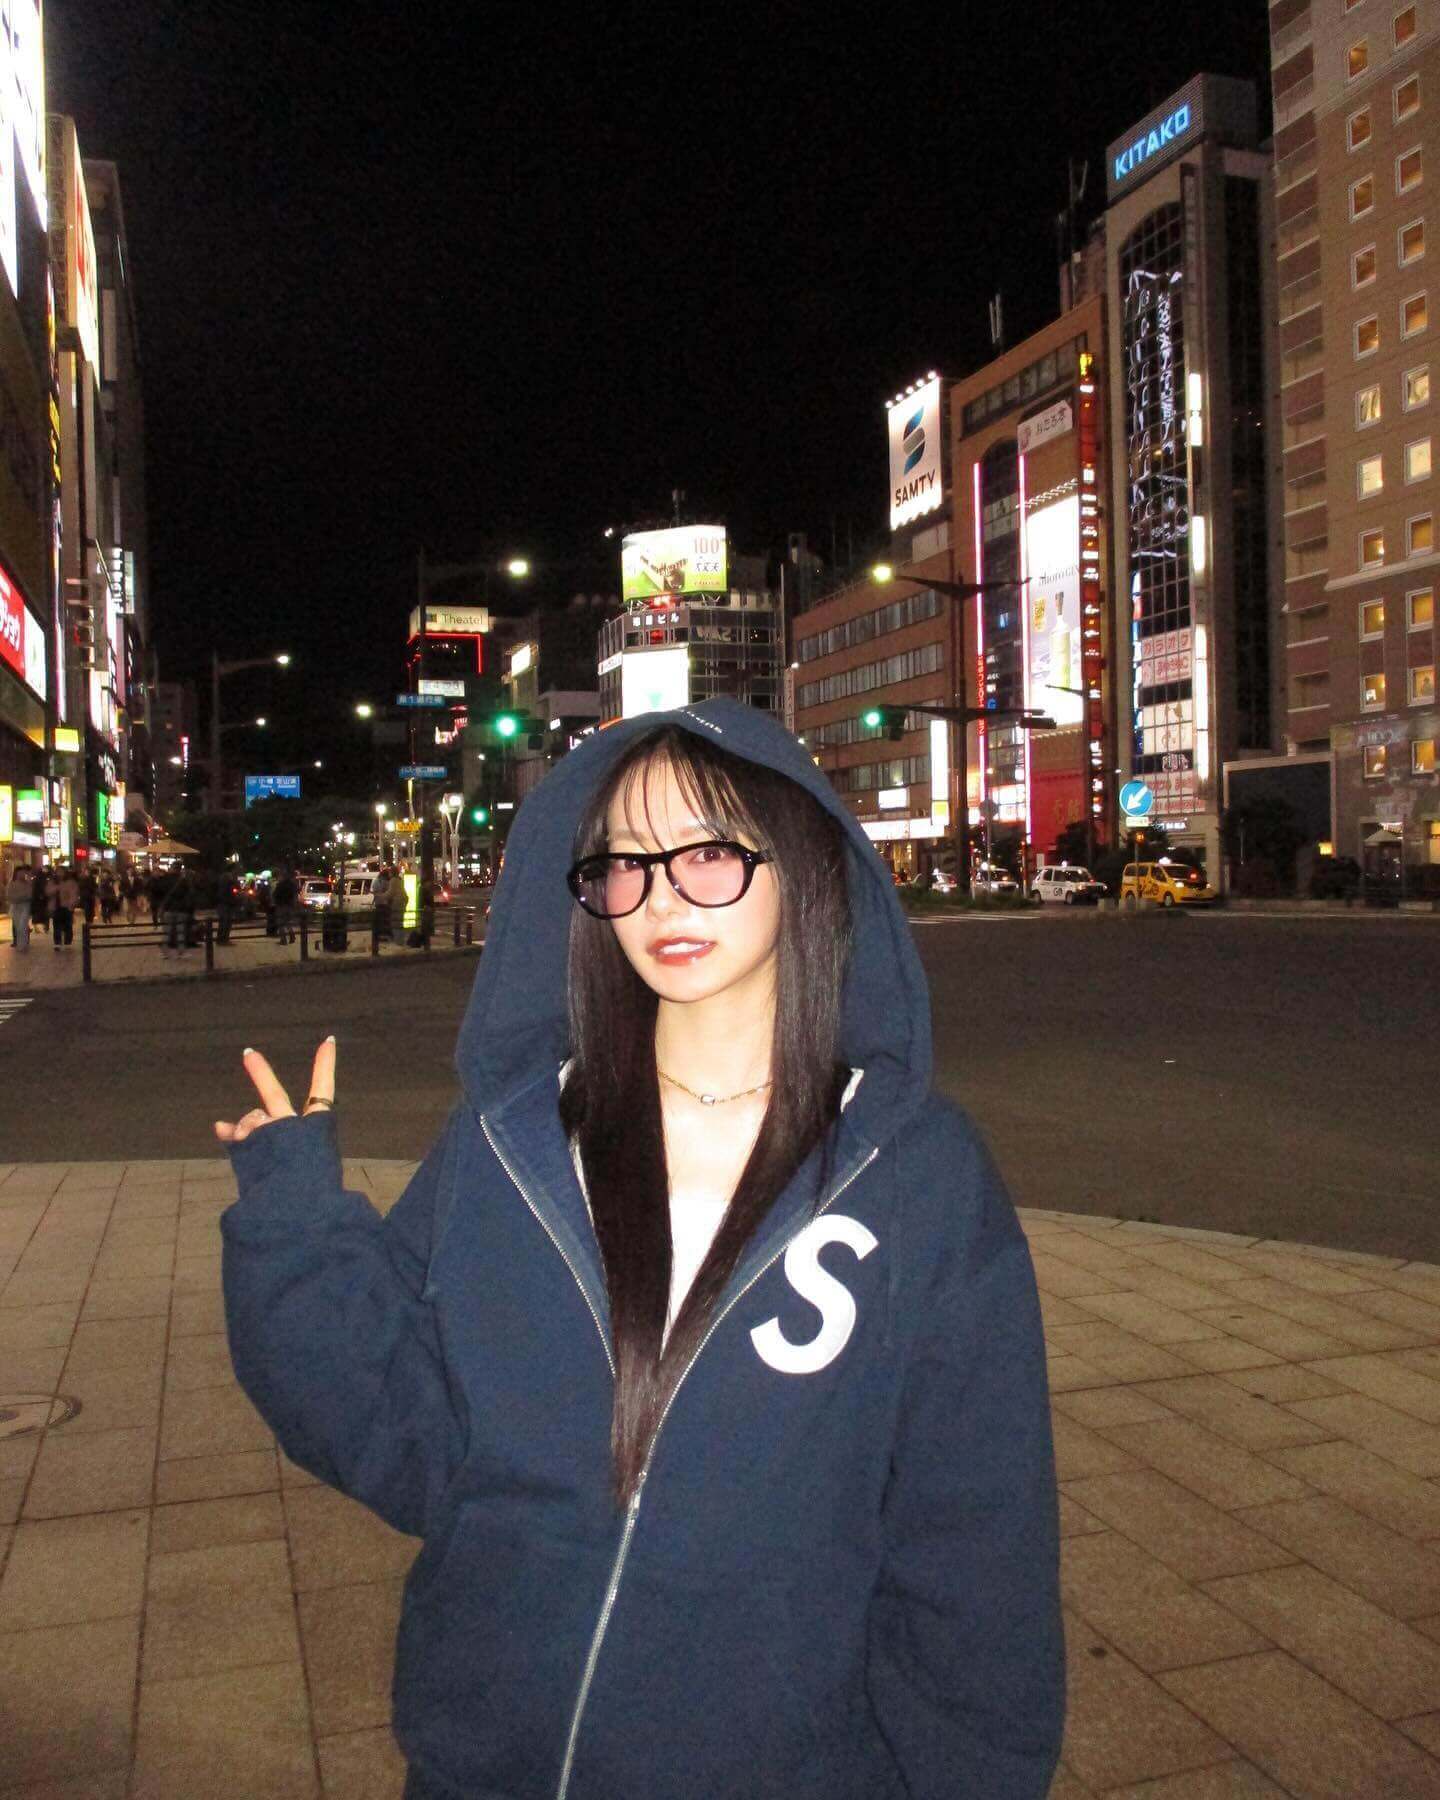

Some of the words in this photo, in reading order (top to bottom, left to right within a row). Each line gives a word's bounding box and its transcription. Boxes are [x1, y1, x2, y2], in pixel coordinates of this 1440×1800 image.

[1114, 104, 1189, 180] KITAKO
[895, 471, 936, 508] SAMTY
[750, 1214, 880, 1374] S
